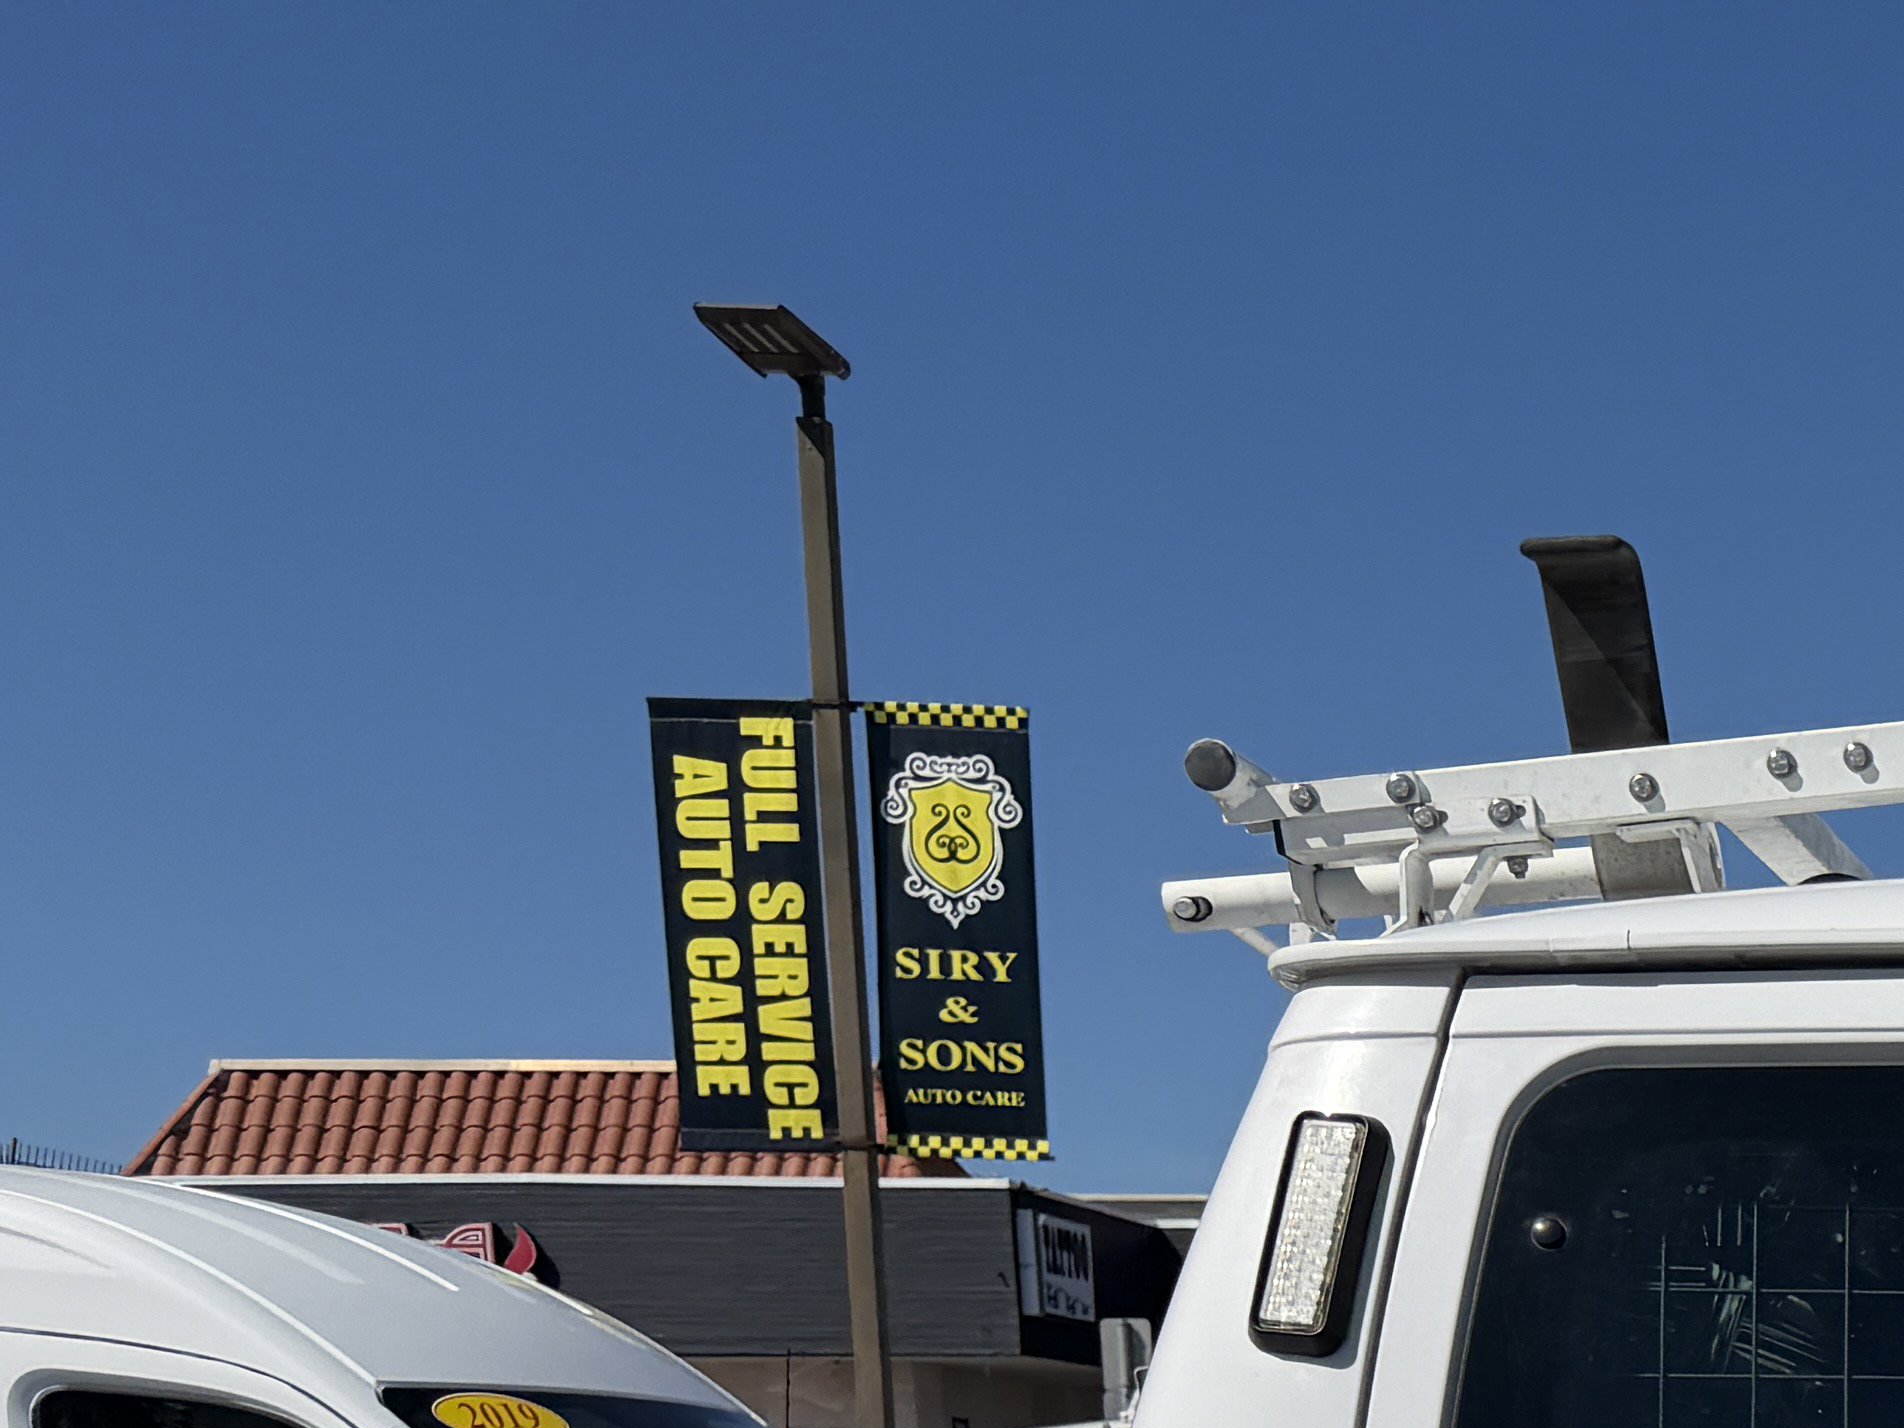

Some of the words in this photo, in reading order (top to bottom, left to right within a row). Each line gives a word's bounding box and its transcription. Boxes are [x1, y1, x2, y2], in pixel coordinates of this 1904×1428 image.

[739, 717, 800, 852] FULL
[672, 754, 737, 921] AUTO
[895, 947, 1019, 983] SIRY
[685, 936, 751, 1097] CARE
[748, 881, 825, 1140] SERVICE
[939, 996, 980, 1024] &
[899, 1038, 1025, 1075] SONS
[904, 1087, 962, 1106] AUTO
[966, 1089, 1025, 1108] CARE
